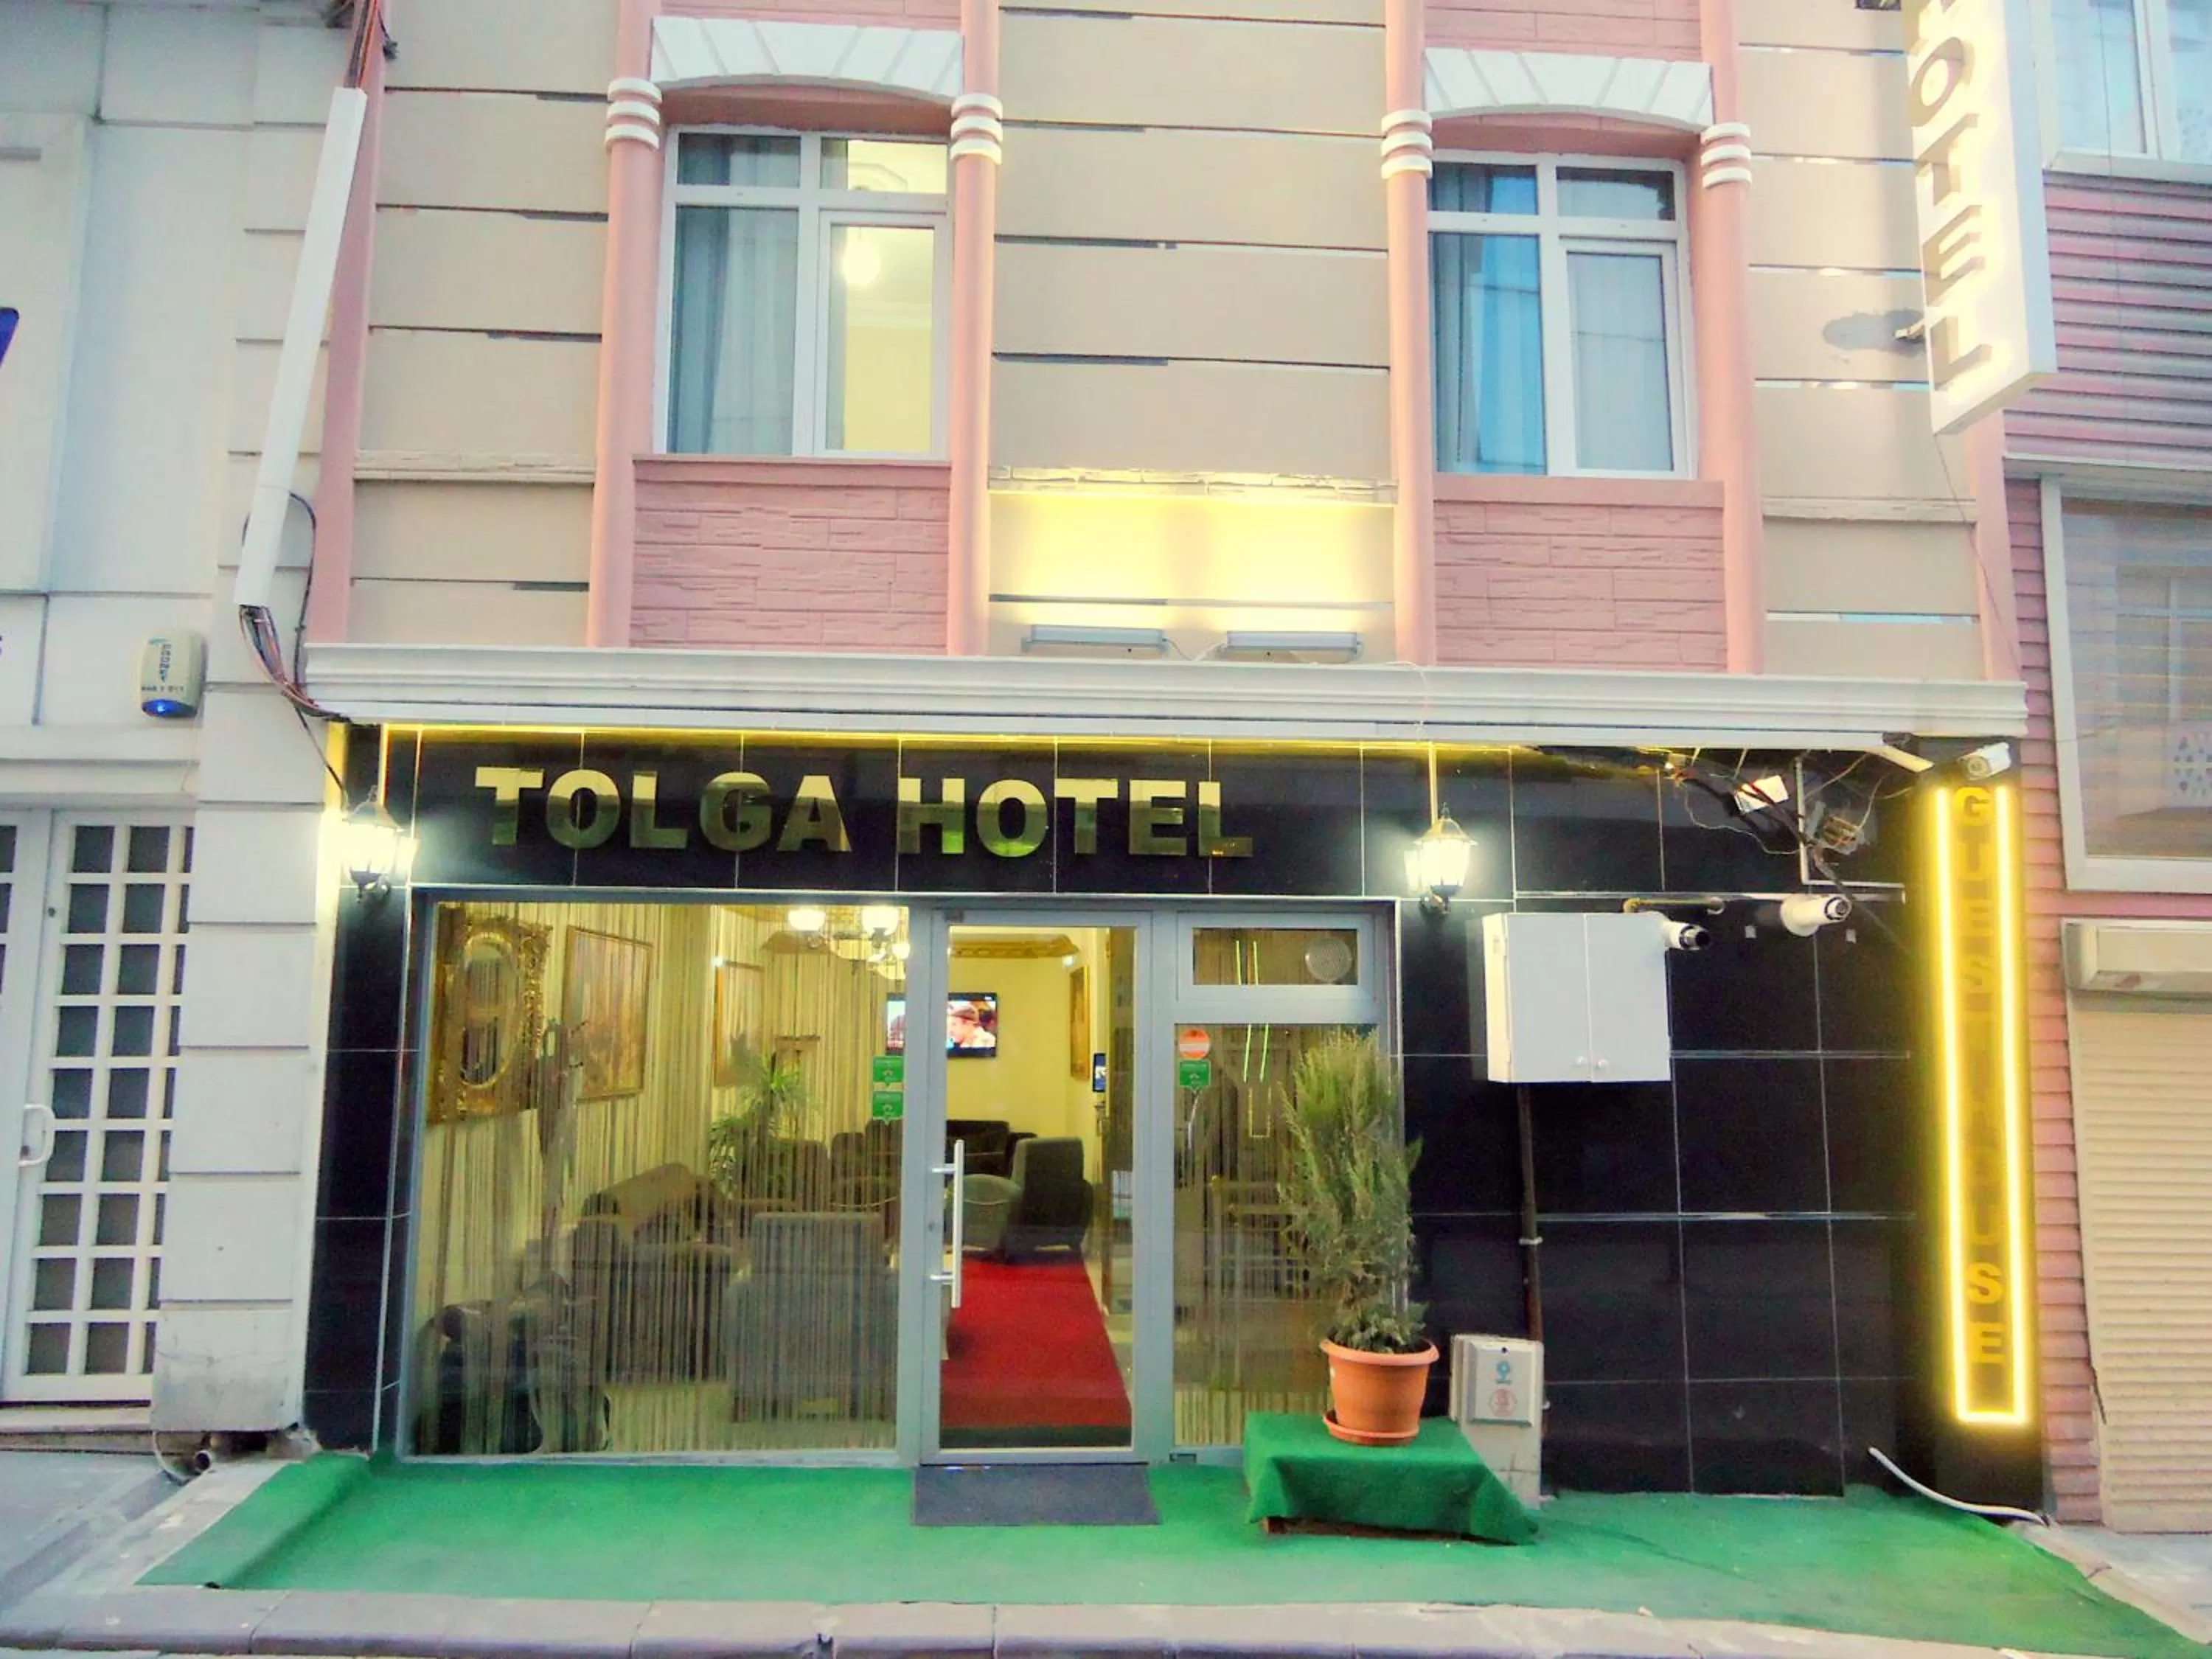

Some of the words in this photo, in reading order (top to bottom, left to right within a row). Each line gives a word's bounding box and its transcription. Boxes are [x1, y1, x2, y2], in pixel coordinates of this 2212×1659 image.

[1910, 0, 1993, 391] OTEL
[473, 768, 852, 851] TOLGA
[898, 778, 1253, 857] HOTEL
